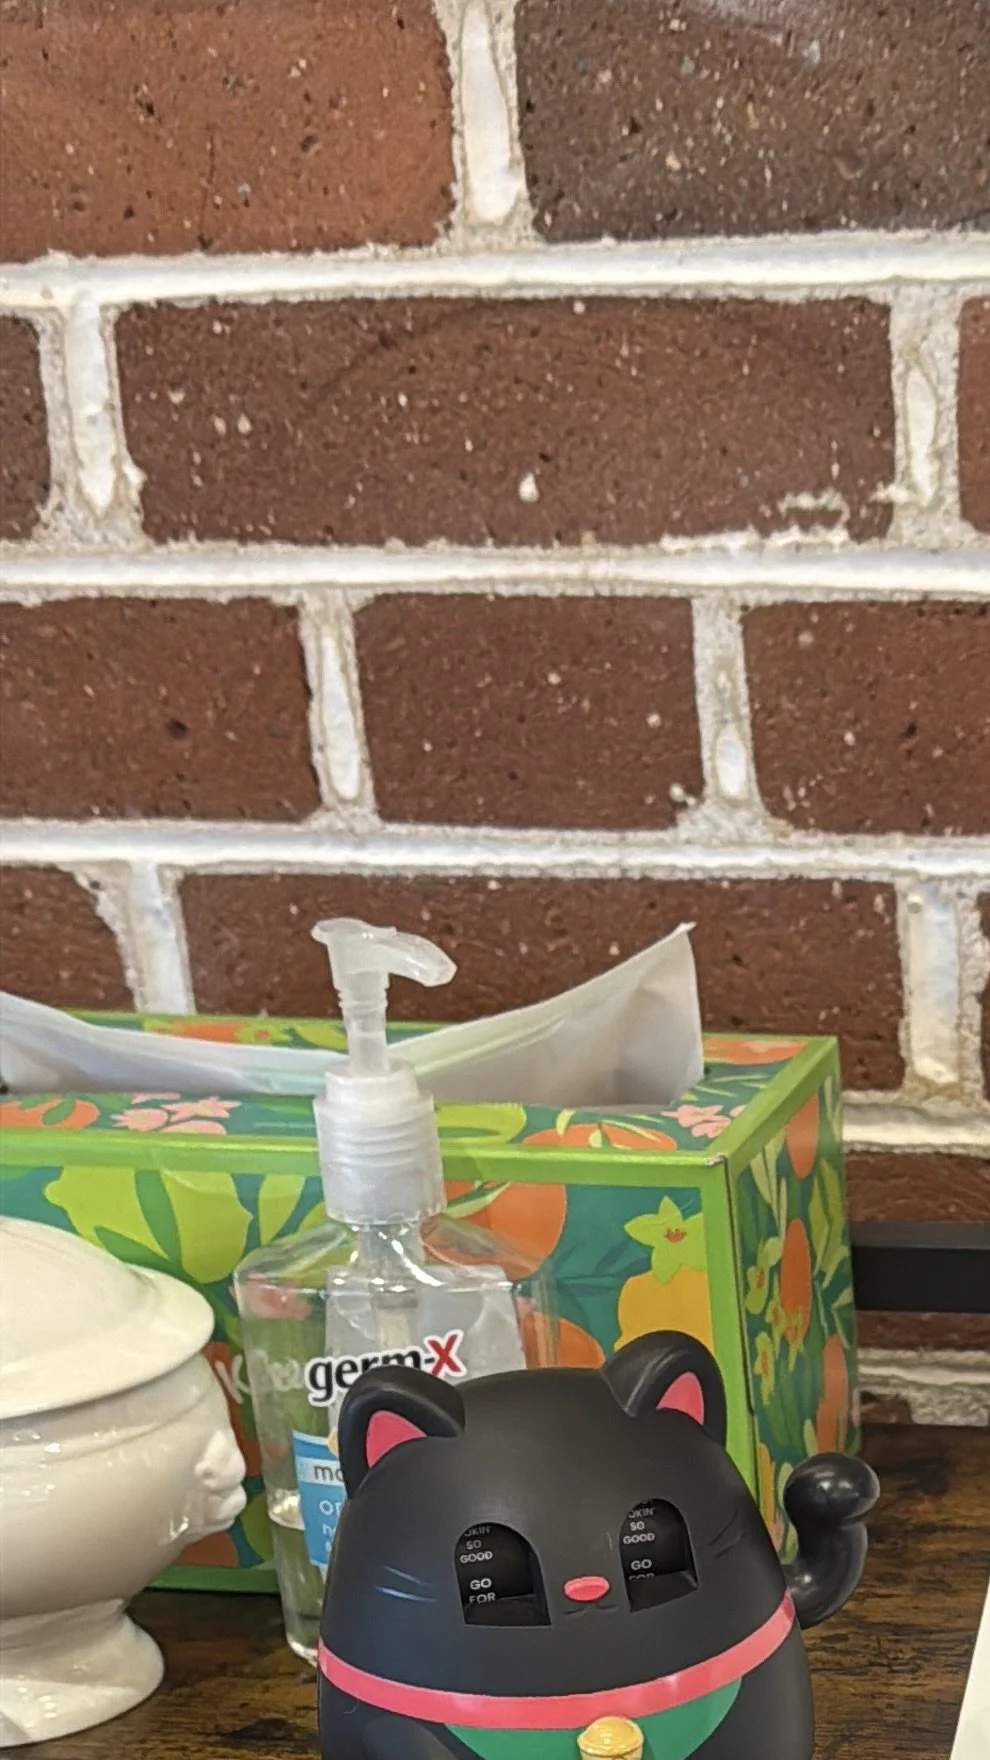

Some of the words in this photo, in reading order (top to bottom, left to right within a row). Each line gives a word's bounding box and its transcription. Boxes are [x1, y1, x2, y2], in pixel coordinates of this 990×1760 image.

[630, 1521, 645, 1532] SO
[466, 1539, 482, 1550] SO
[623, 1533, 655, 1545] GOOD
[460, 1551, 493, 1564] GOOD
[631, 1559, 652, 1571] GO
[470, 1577, 492, 1590] GO
[469, 1592, 496, 1604] FOR
